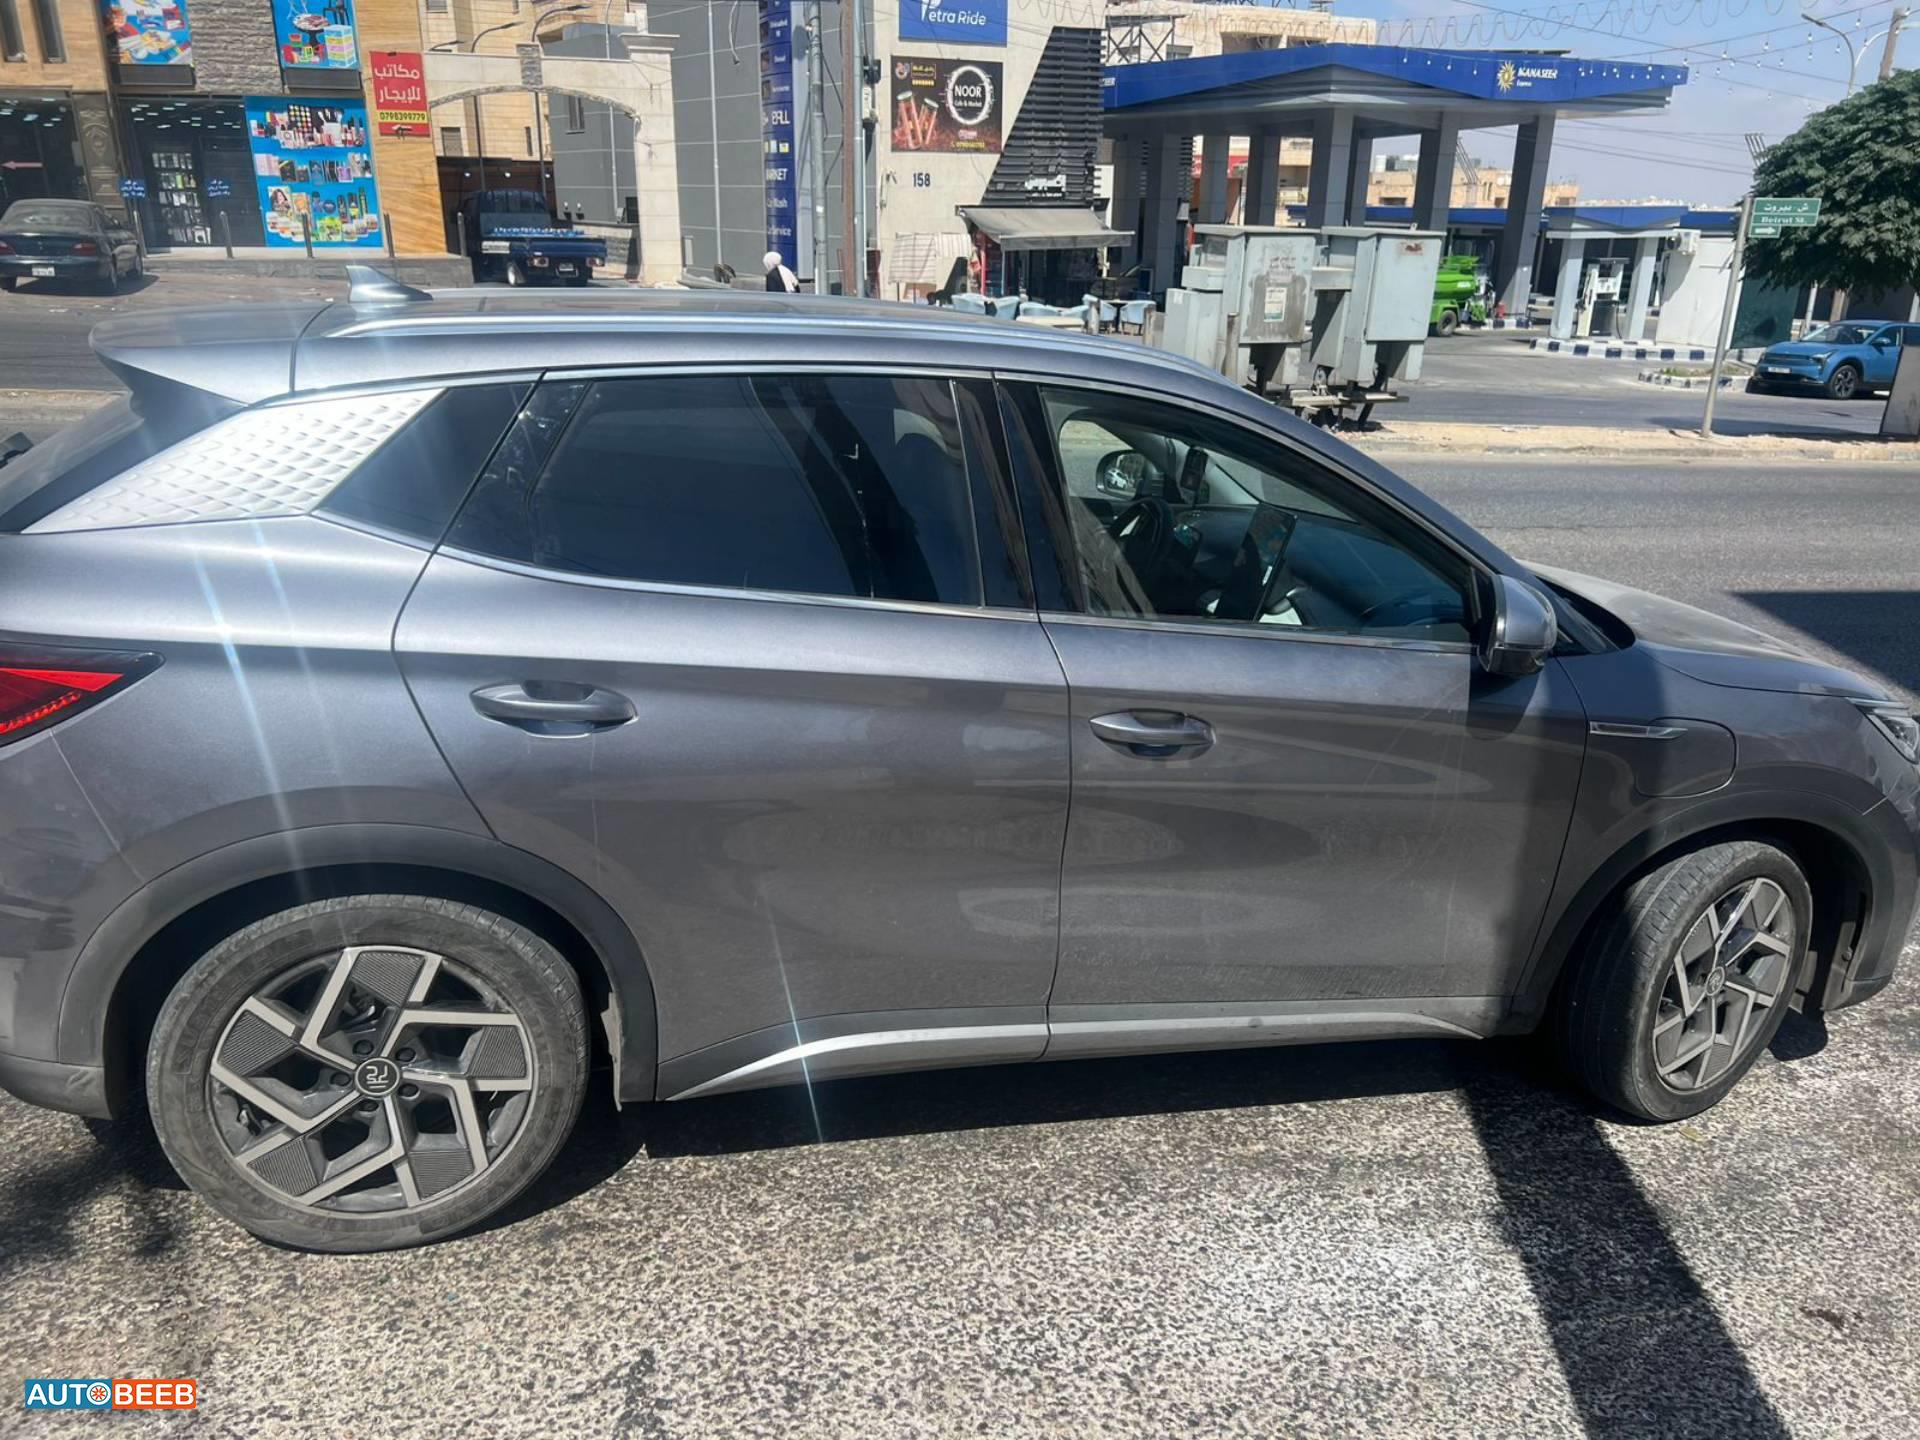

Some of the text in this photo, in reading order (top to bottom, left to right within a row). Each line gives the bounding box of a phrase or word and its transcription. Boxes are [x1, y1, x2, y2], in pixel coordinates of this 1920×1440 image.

[957, 10, 987, 26] Ride
[374, 64, 420, 80] مكاتب
[954, 85, 983, 98] NOOR
[912, 172, 931, 188] 158
[1764, 203, 1792, 213] بيروت
